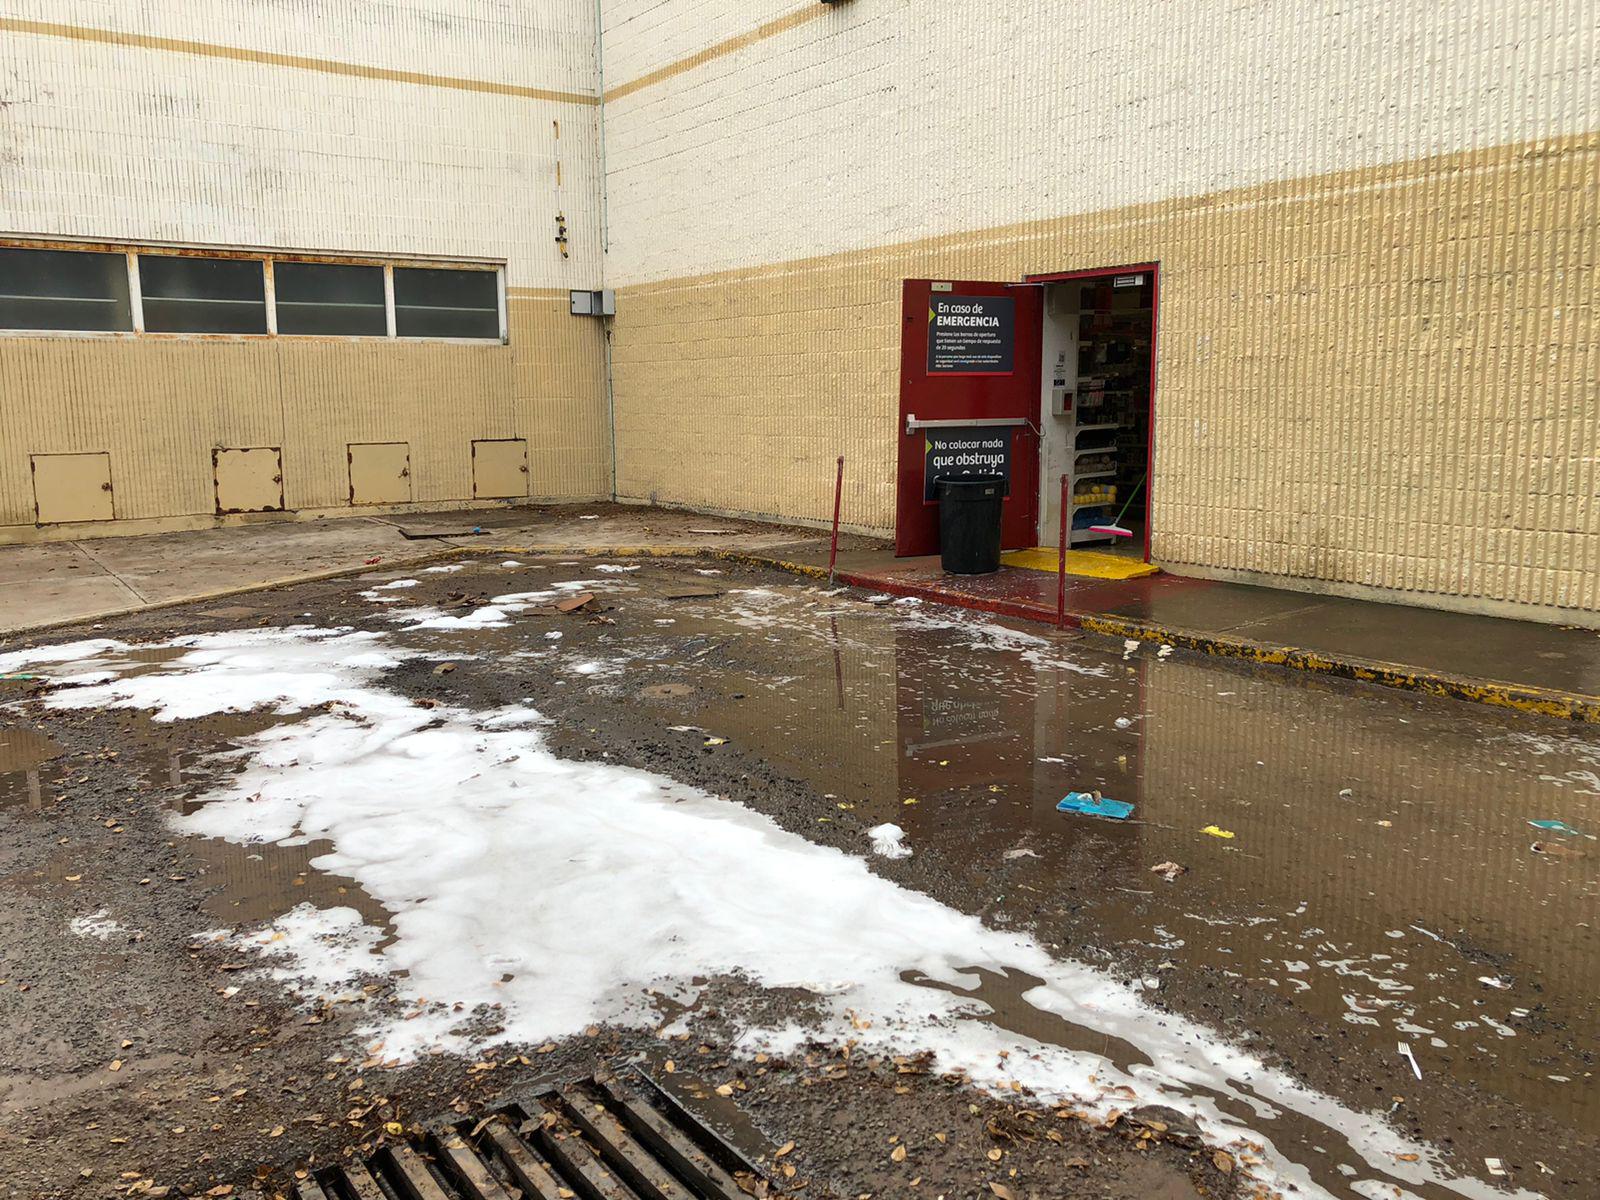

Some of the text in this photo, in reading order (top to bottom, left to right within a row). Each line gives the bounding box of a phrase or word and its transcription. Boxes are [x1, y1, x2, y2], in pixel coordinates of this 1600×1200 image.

[938, 302, 983, 314] En caso de
[937, 316, 999, 327] EMERGENCIA
[934, 438, 1003, 449] No colocar nada
[933, 452, 1004, 469] que obstruya
